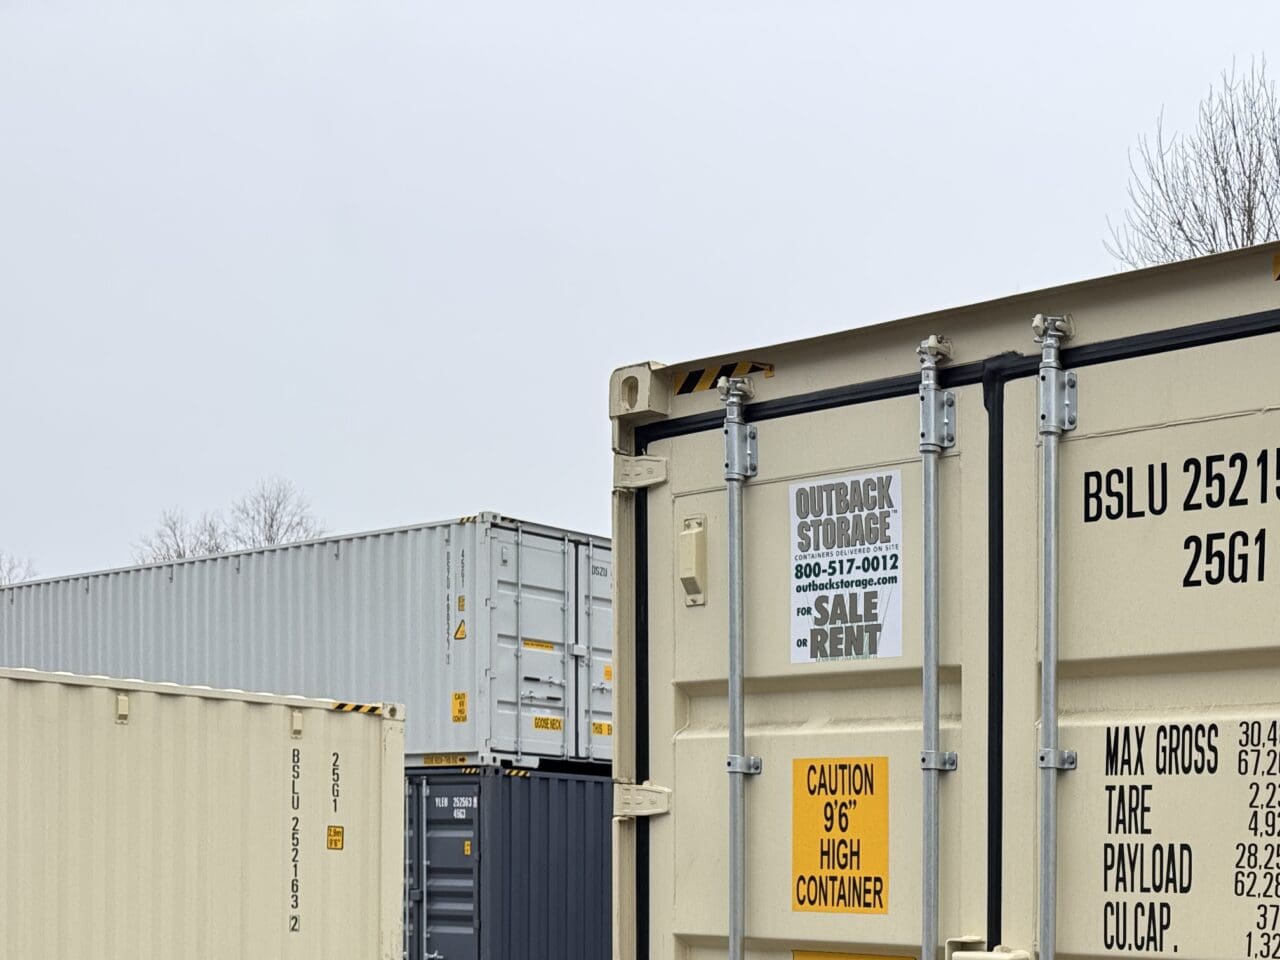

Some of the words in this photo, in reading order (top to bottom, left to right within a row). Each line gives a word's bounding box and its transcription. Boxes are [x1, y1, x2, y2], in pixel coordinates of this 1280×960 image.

[796, 475, 894, 519] OUTBACK
[1084, 462, 1168, 522] BSLU
[797, 511, 892, 552] STORAGE
[794, 550, 834, 560] CONTAINERS
[836, 547, 870, 556] DELIVERED
[795, 554, 899, 579] 800-517-0012
[1183, 528, 1266, 588] 25G1
[796, 576, 897, 593] outbackstorage.com
[797, 607, 812, 616] FOR
[814, 591, 878, 626] SALE
[796, 639, 807, 648] OR
[810, 624, 882, 658] RENT
[1105, 726, 1146, 776] MAX
[1156, 724, 1218, 775] GROSS
[292, 749, 300, 810] BSLU
[807, 764, 874, 796] CAUTION
[1105, 785, 1152, 834] TARE
[291, 816, 299, 909] 252163
[820, 838, 860, 870] HIGH
[1104, 843, 1192, 893] PAYLOAD
[796, 875, 883, 908] CONTAINER
[291, 916, 298, 931] 2
[1104, 902, 1178, 953] CU.CAP.
